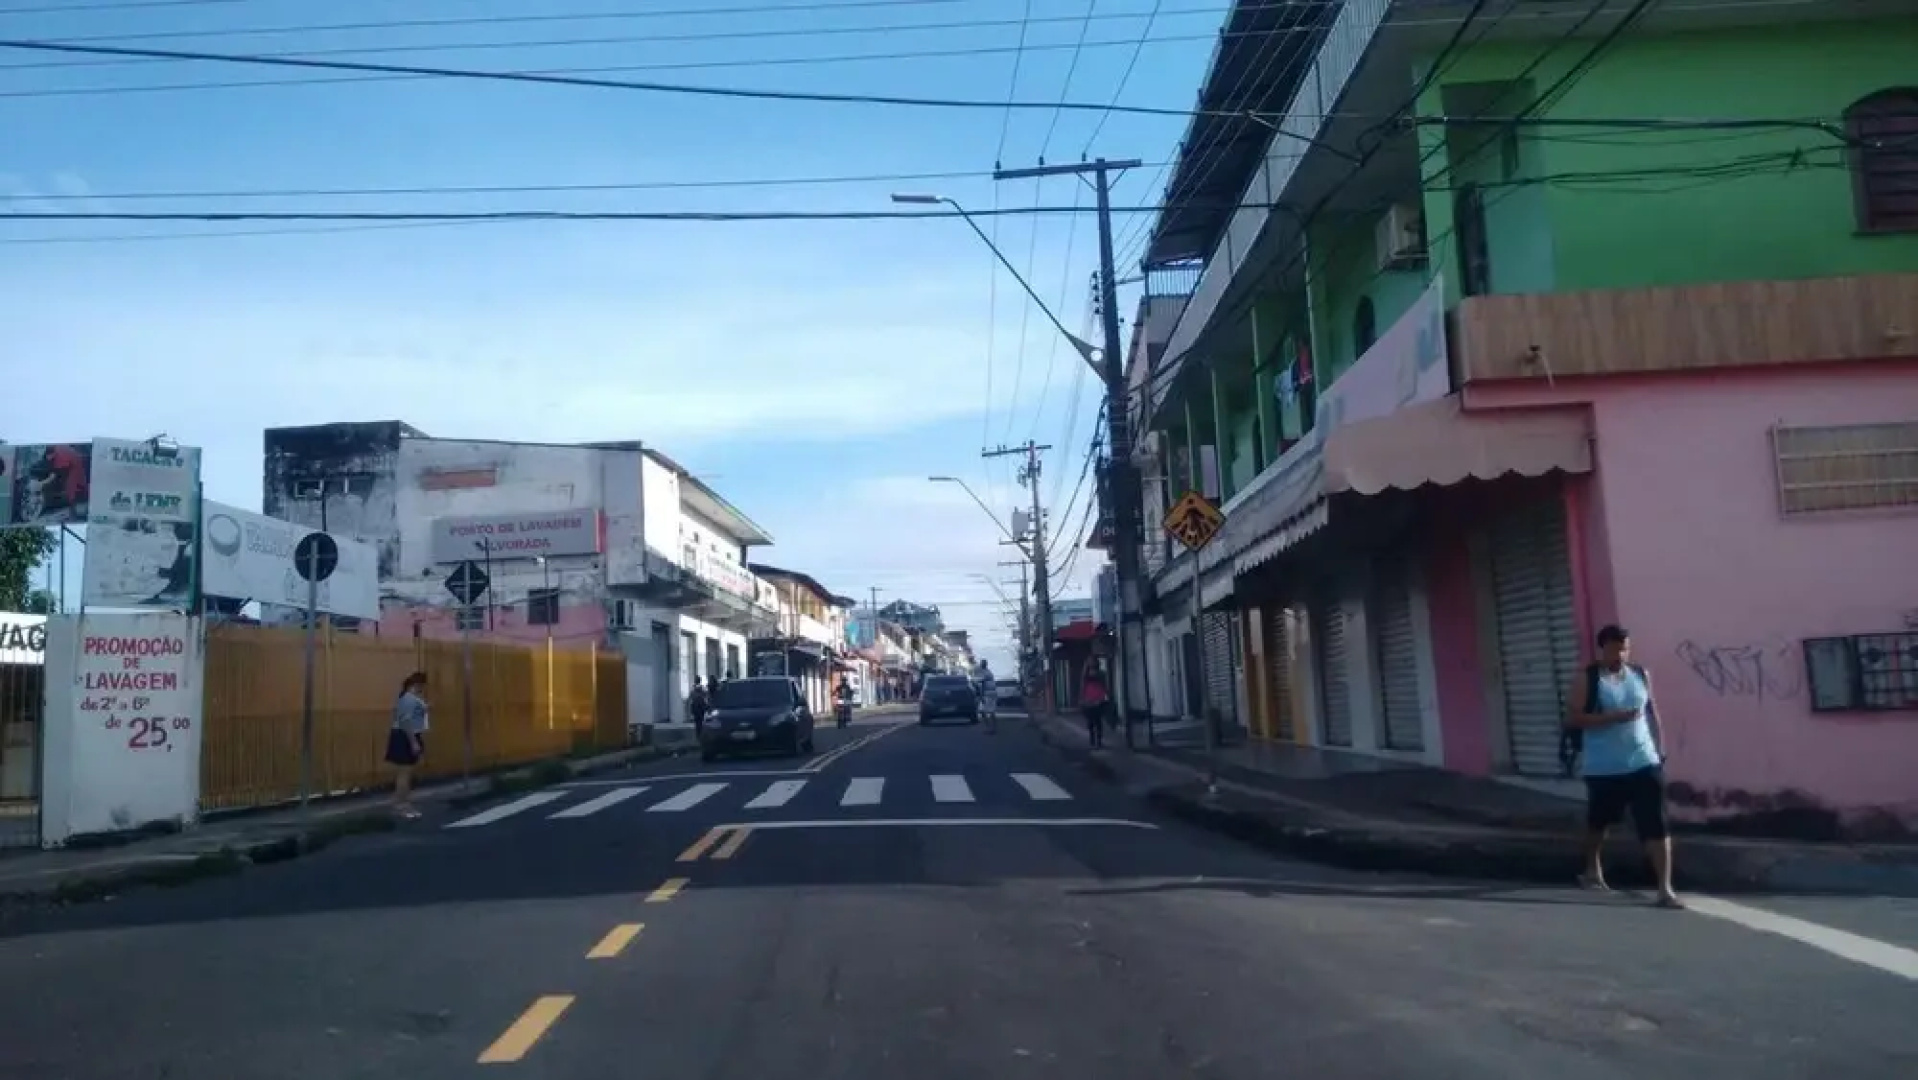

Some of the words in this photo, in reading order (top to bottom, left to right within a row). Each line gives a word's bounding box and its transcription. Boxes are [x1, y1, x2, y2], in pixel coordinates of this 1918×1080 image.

[498, 522, 515, 534] DE
[484, 537, 552, 551] LVORADA
[84, 635, 184, 657] PROMOÇÃO
[122, 657, 141, 670] DE
[85, 672, 177, 691] LAVAGEM
[105, 713, 122, 730] de
